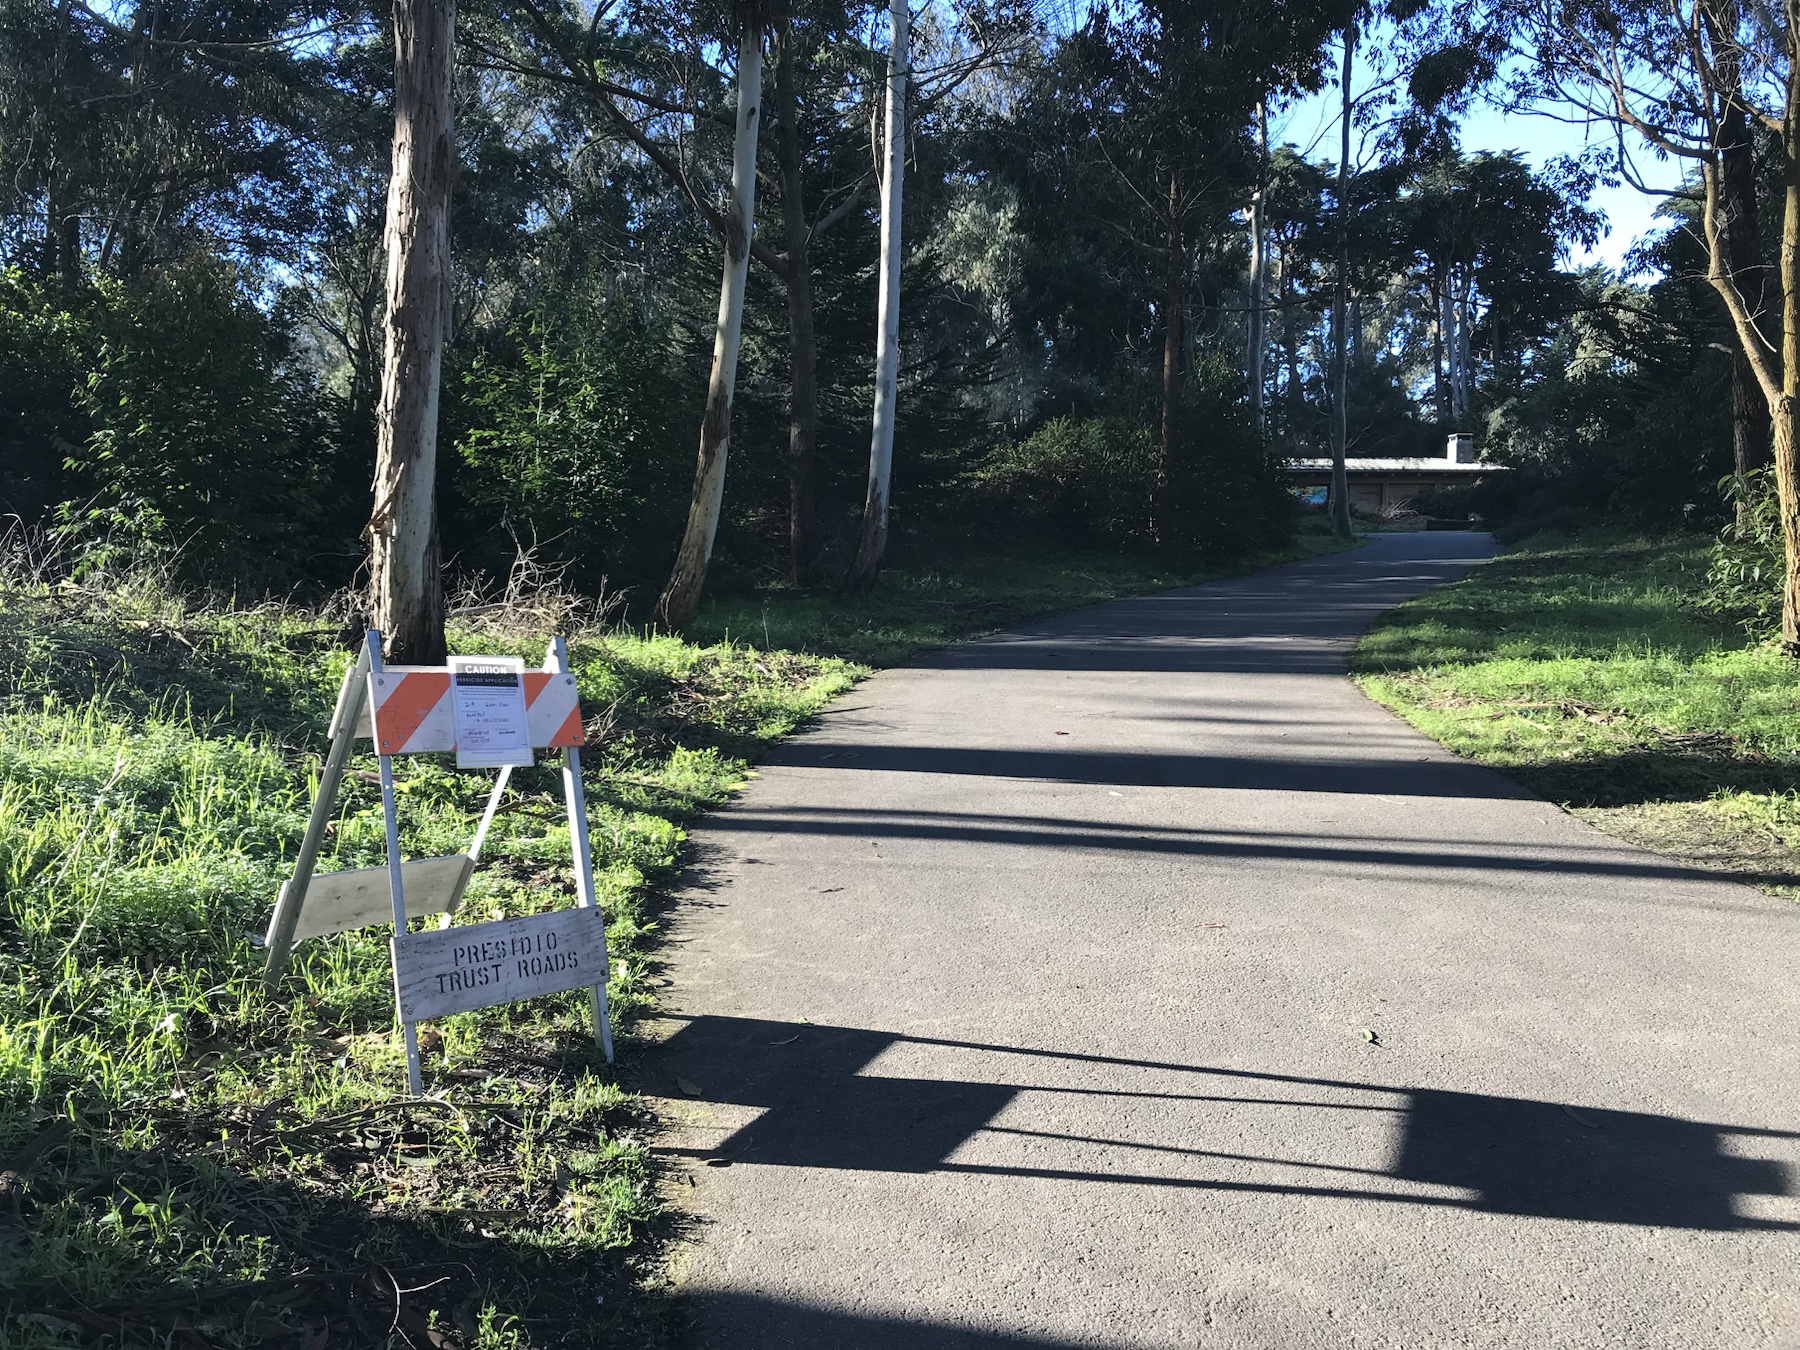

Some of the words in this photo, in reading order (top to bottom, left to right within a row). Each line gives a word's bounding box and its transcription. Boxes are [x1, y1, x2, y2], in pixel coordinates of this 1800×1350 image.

[465, 665, 507, 674] CAUTION
[453, 931, 558, 967] PRESIDIO
[435, 964, 502, 994] TRUST
[517, 951, 579, 979] ROADS
